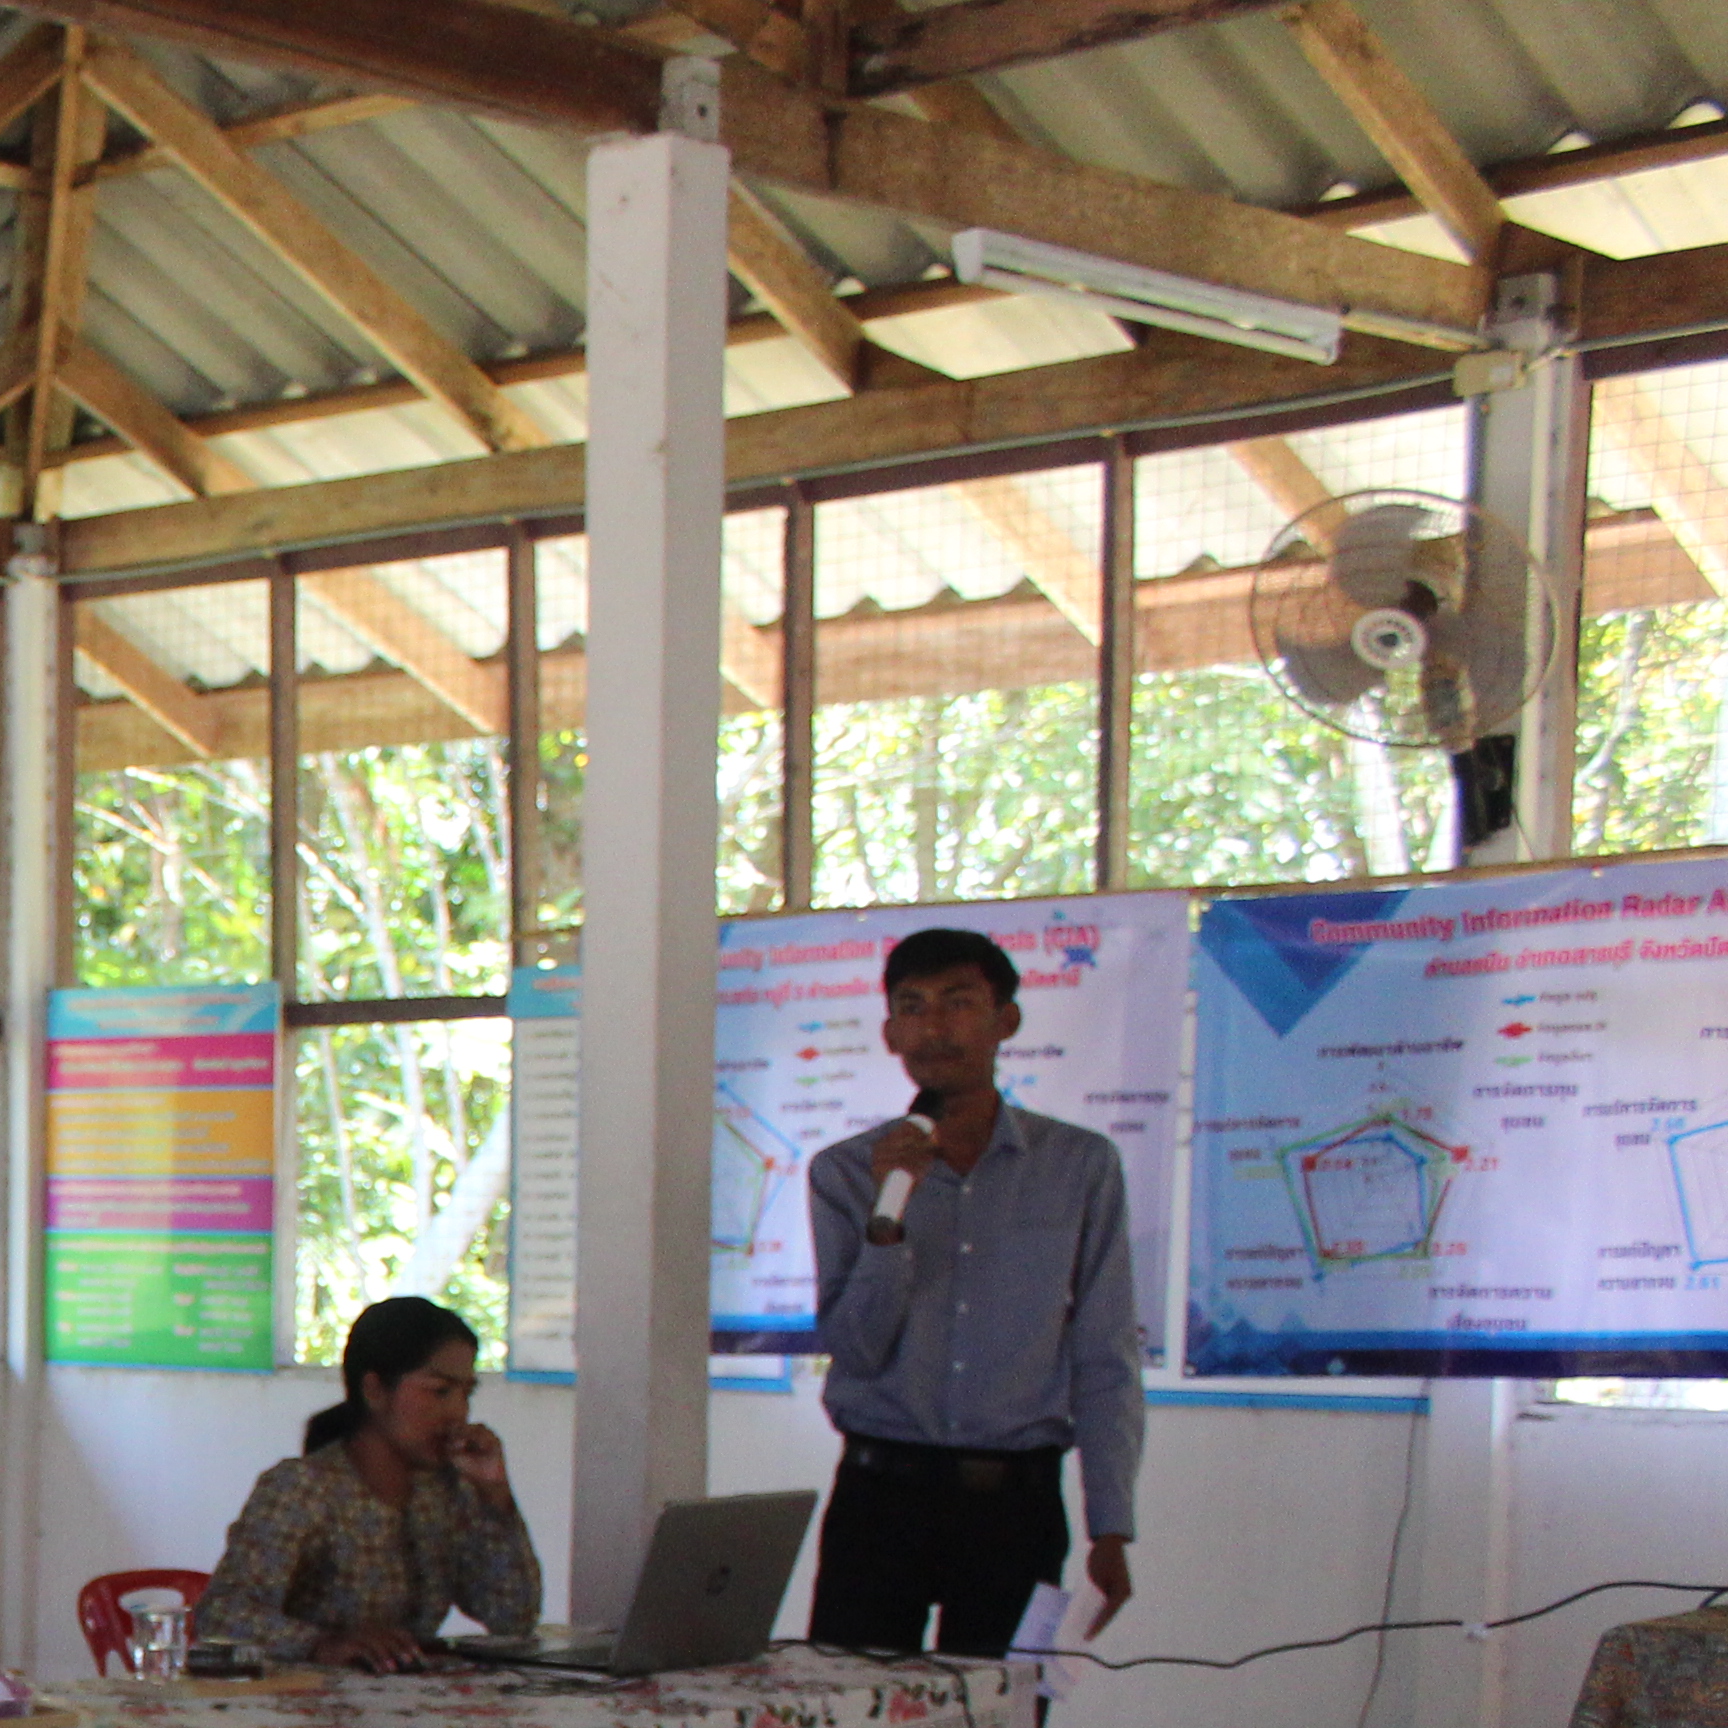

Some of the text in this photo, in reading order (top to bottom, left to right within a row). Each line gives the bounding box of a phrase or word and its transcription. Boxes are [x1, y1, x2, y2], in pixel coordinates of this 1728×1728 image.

[1310, 914, 1455, 945] Community
[1461, 898, 1613, 935] Information
[1621, 893, 1701, 920] Radar
